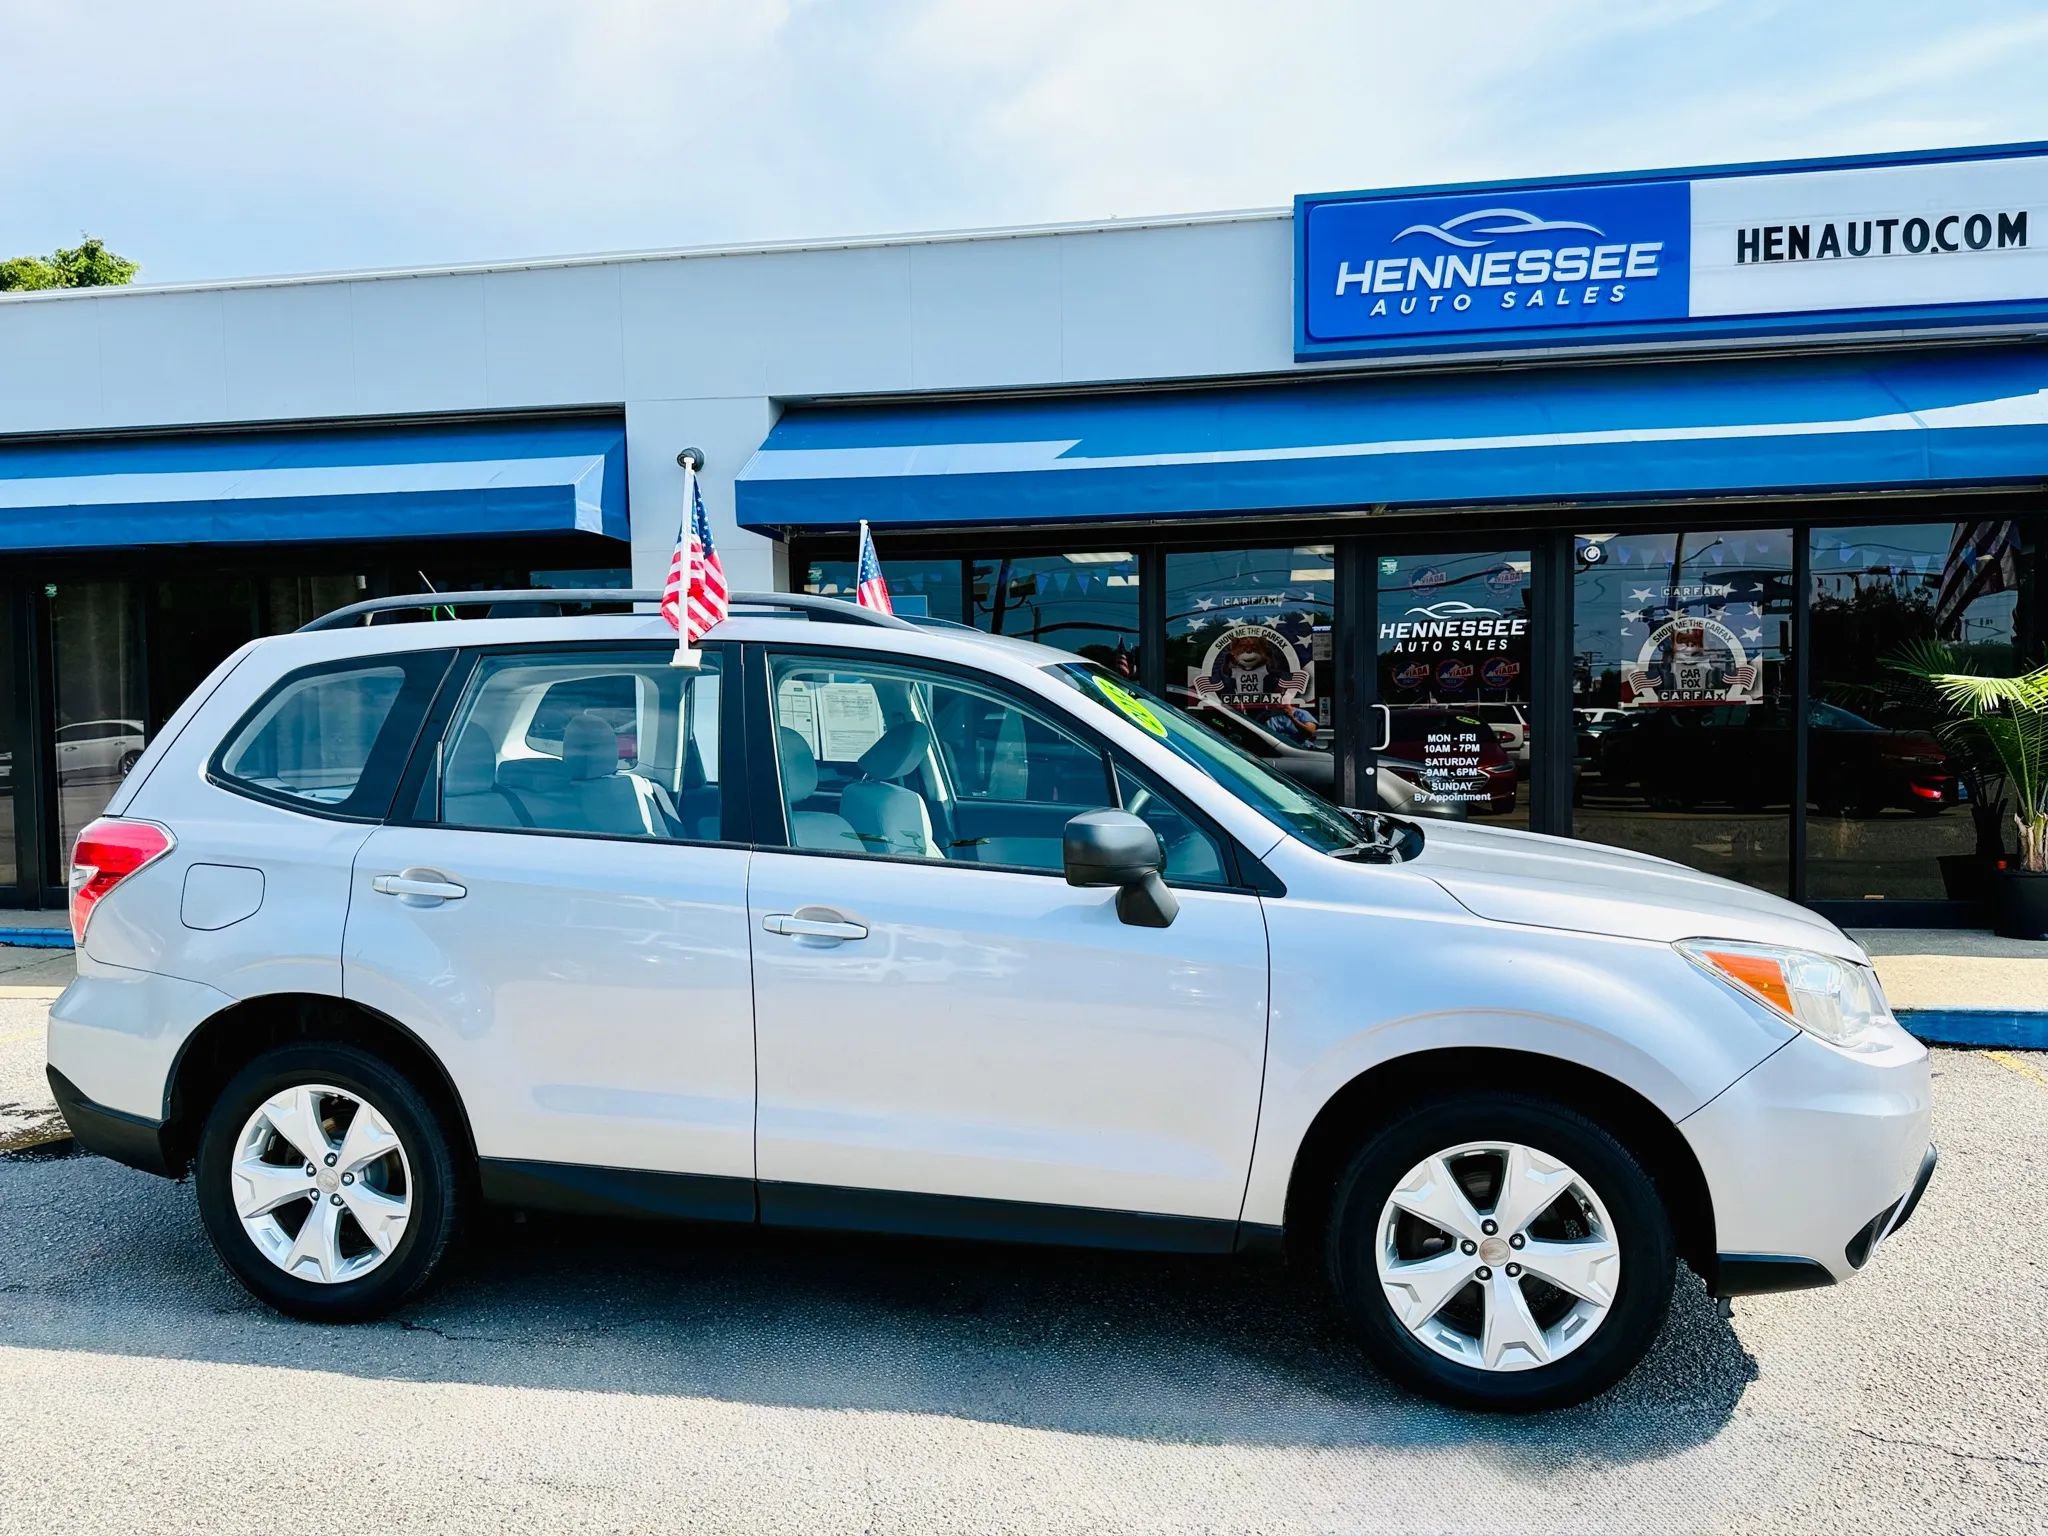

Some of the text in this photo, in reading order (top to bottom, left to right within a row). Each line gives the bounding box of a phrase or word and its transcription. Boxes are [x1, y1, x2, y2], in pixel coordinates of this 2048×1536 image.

[1736, 211, 2028, 264] HENAUTO.COM
[1335, 241, 1664, 298] HENNESSEE
[1369, 284, 1629, 317] AUTO SALES
[1662, 586, 1723, 597] CARFAX
[1222, 595, 1278, 607] CARFAX
[1379, 619, 1528, 639] HENNESSEE
[1652, 619, 1734, 644] SHOW ME THE CARFAX
[1215, 627, 1288, 650] SHOW ME THE CARFAX
[1394, 639, 1509, 653] AUTO SALES
[1240, 673, 1258, 684] CAR
[1680, 668, 1701, 679] CAR
[1241, 683, 1259, 693] FOX
[1681, 679, 1701, 689] FOX
[1223, 694, 1282, 704] CARFAX
[1660, 690, 1726, 701] CARFAX
[1427, 733, 1451, 743] MON
[1459, 733, 1477, 742] FRI
[1424, 744, 1451, 753] 10AM
[1459, 743, 1480, 753] 7PM
[1424, 757, 1479, 767] SATURDAY
[1426, 768, 1448, 777] 9AM
[1456, 767, 1478, 776] 6PM
[1431, 781, 1473, 791] SUNDAY
[1414, 792, 1492, 803] By Appointment
